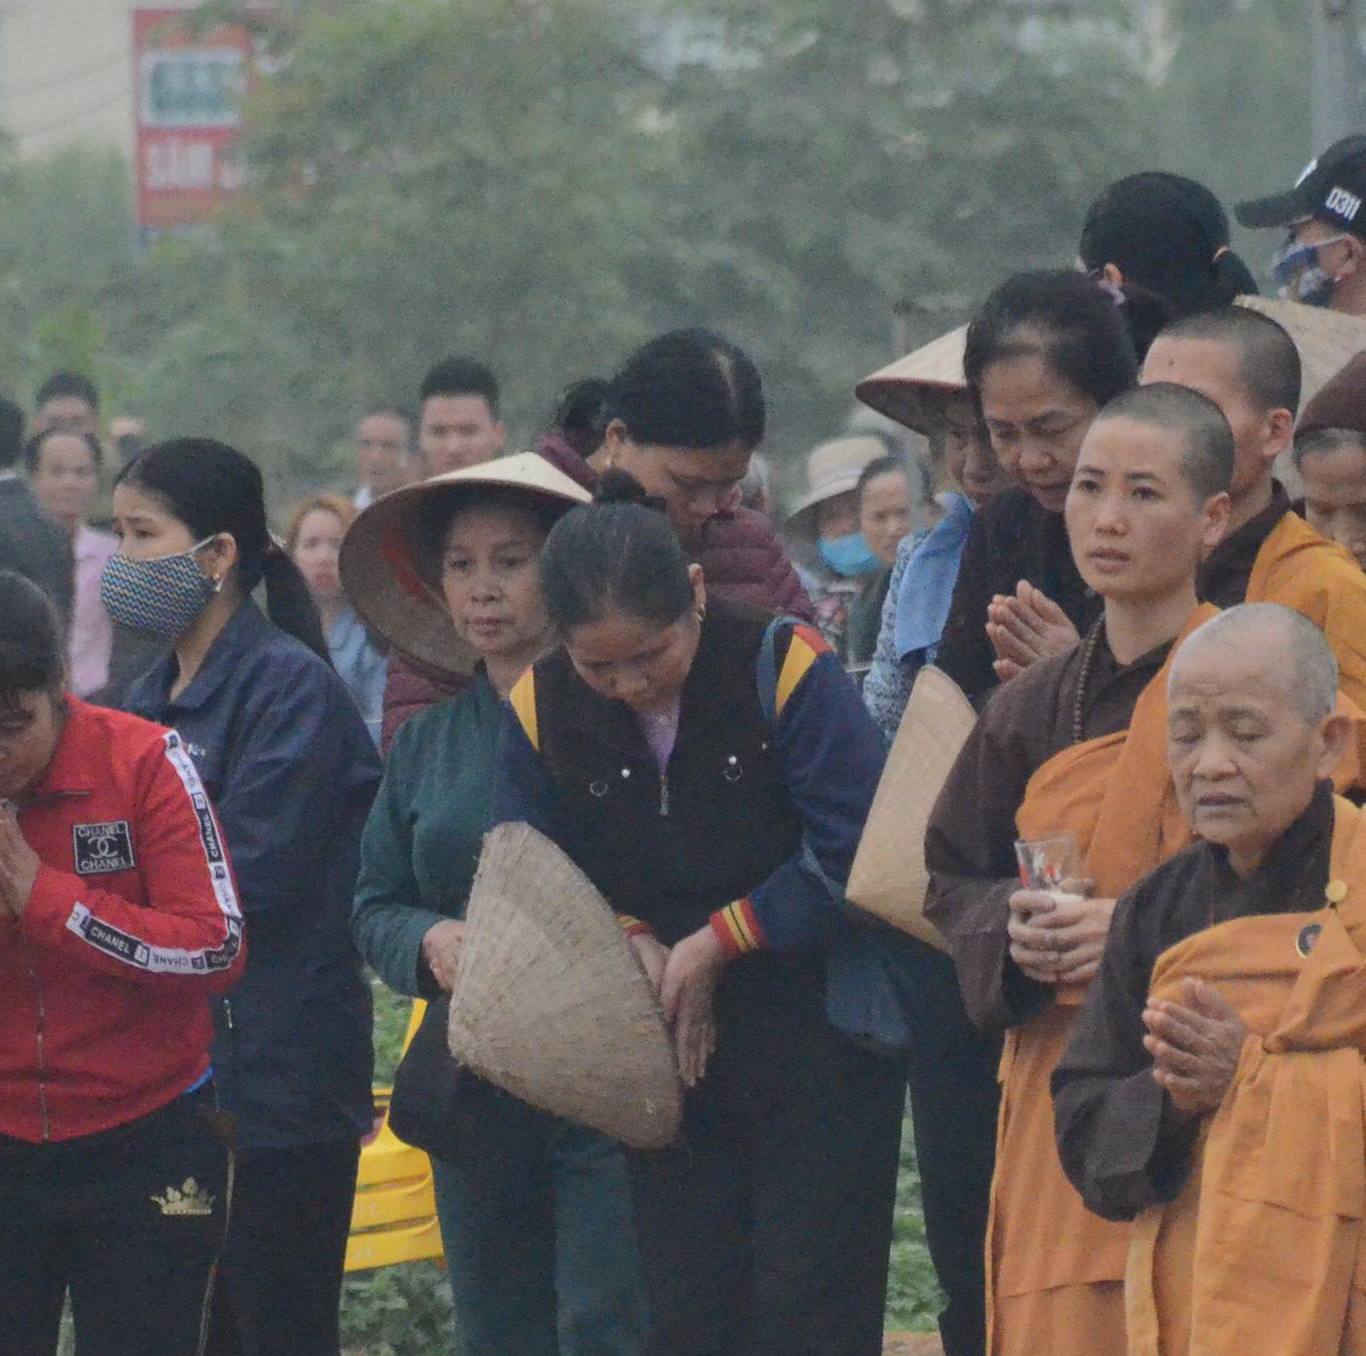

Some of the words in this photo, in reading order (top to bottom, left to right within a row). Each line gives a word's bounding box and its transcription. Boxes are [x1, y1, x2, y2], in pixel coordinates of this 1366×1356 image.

[77, 824, 124, 837] CHANEL
[202, 814, 220, 858] CHANEL
[81, 857, 127, 870] CHANEL
[90, 928, 131, 954] CHANEL
